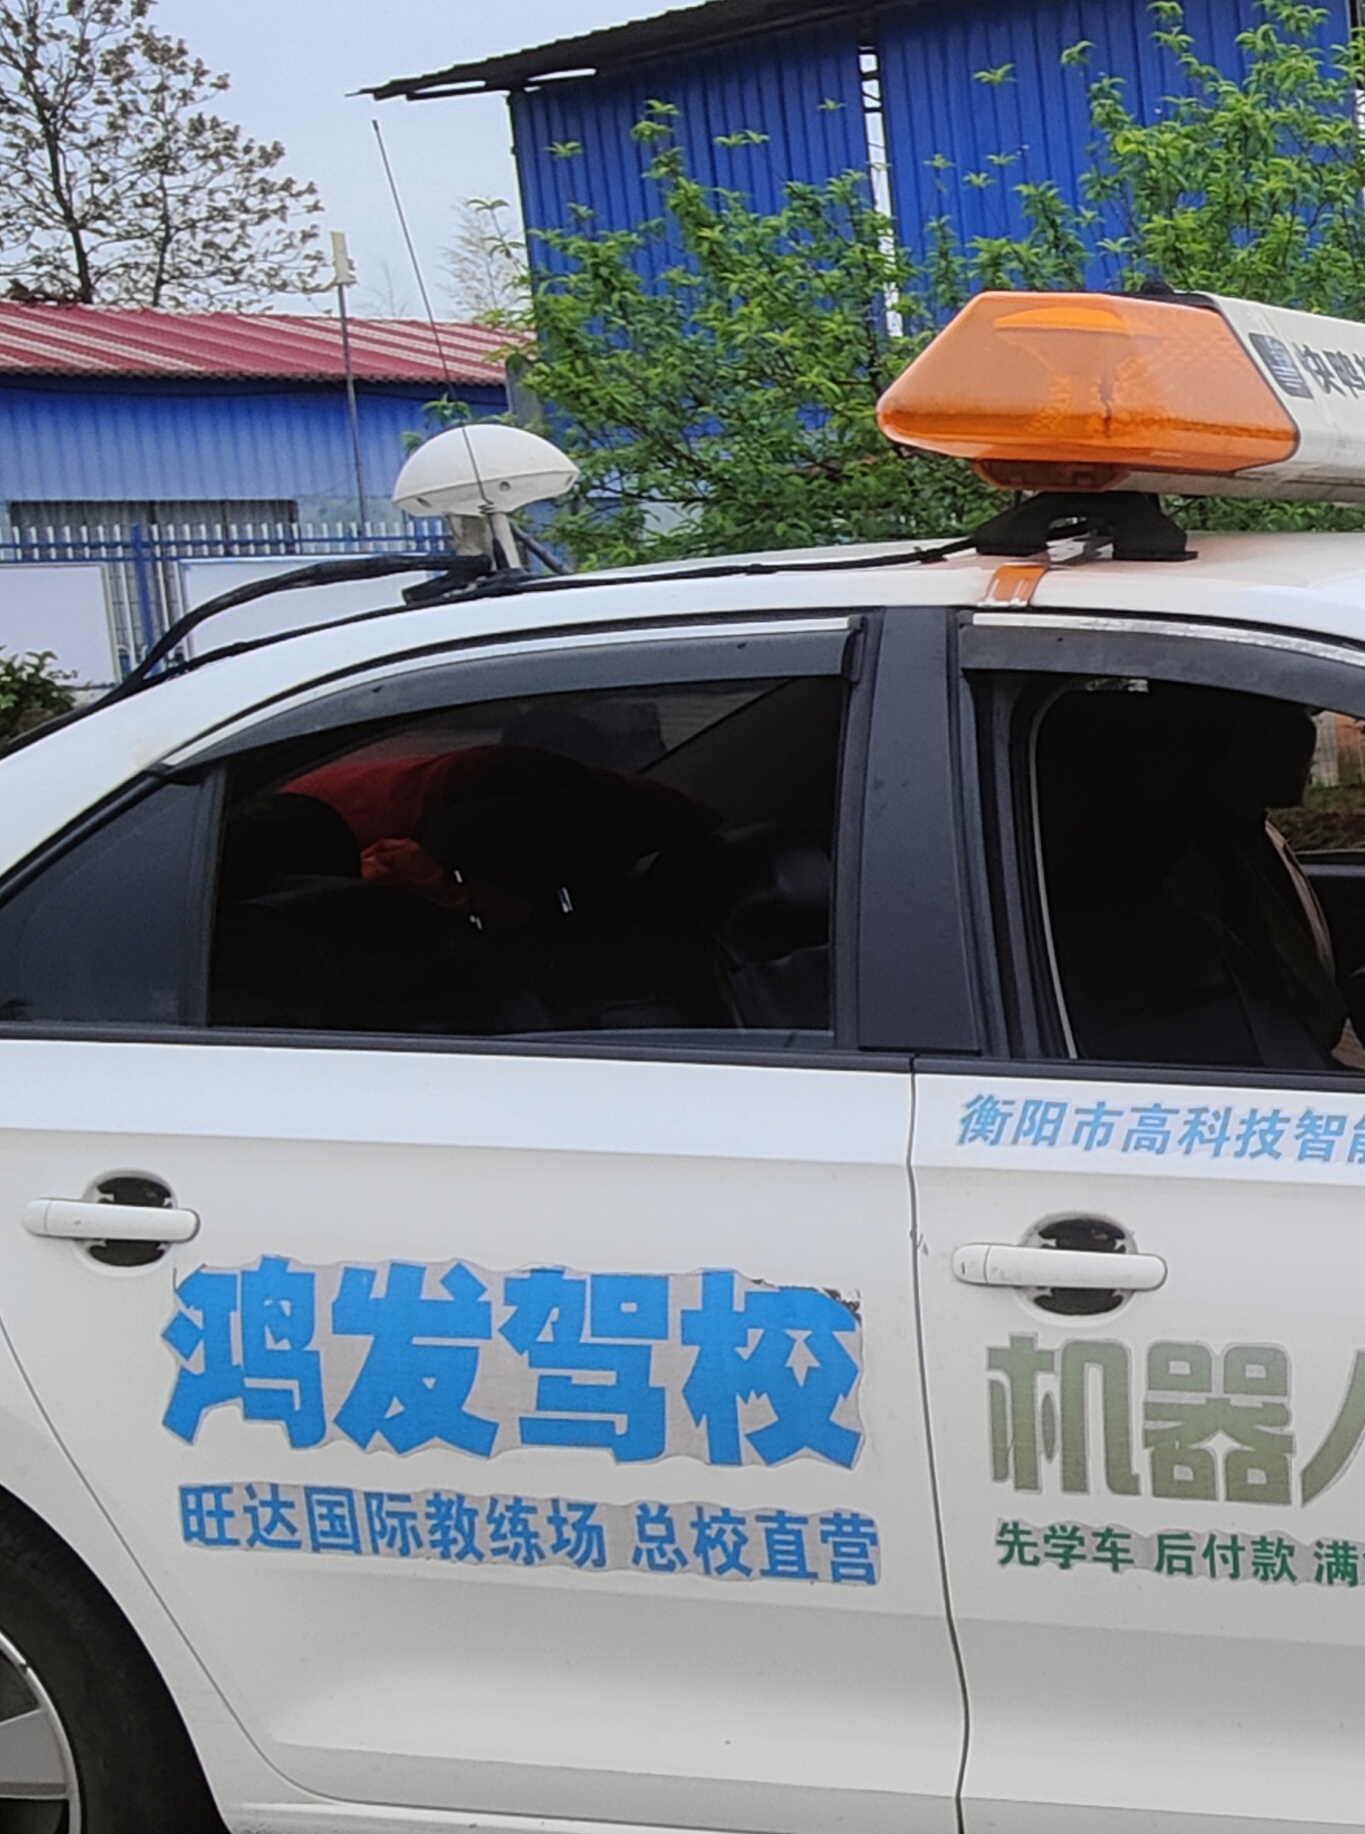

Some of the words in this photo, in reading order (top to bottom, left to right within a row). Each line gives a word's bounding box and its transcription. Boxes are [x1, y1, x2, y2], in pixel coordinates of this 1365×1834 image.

[162, 1256, 863, 1470] 鸿发驾校
[178, 1485, 606, 1567] 旺达国际教练场
[632, 1502, 880, 1586] 总校直营
[995, 1520, 1136, 1570] 先学车
[1153, 1532, 1299, 1583] 后付款
